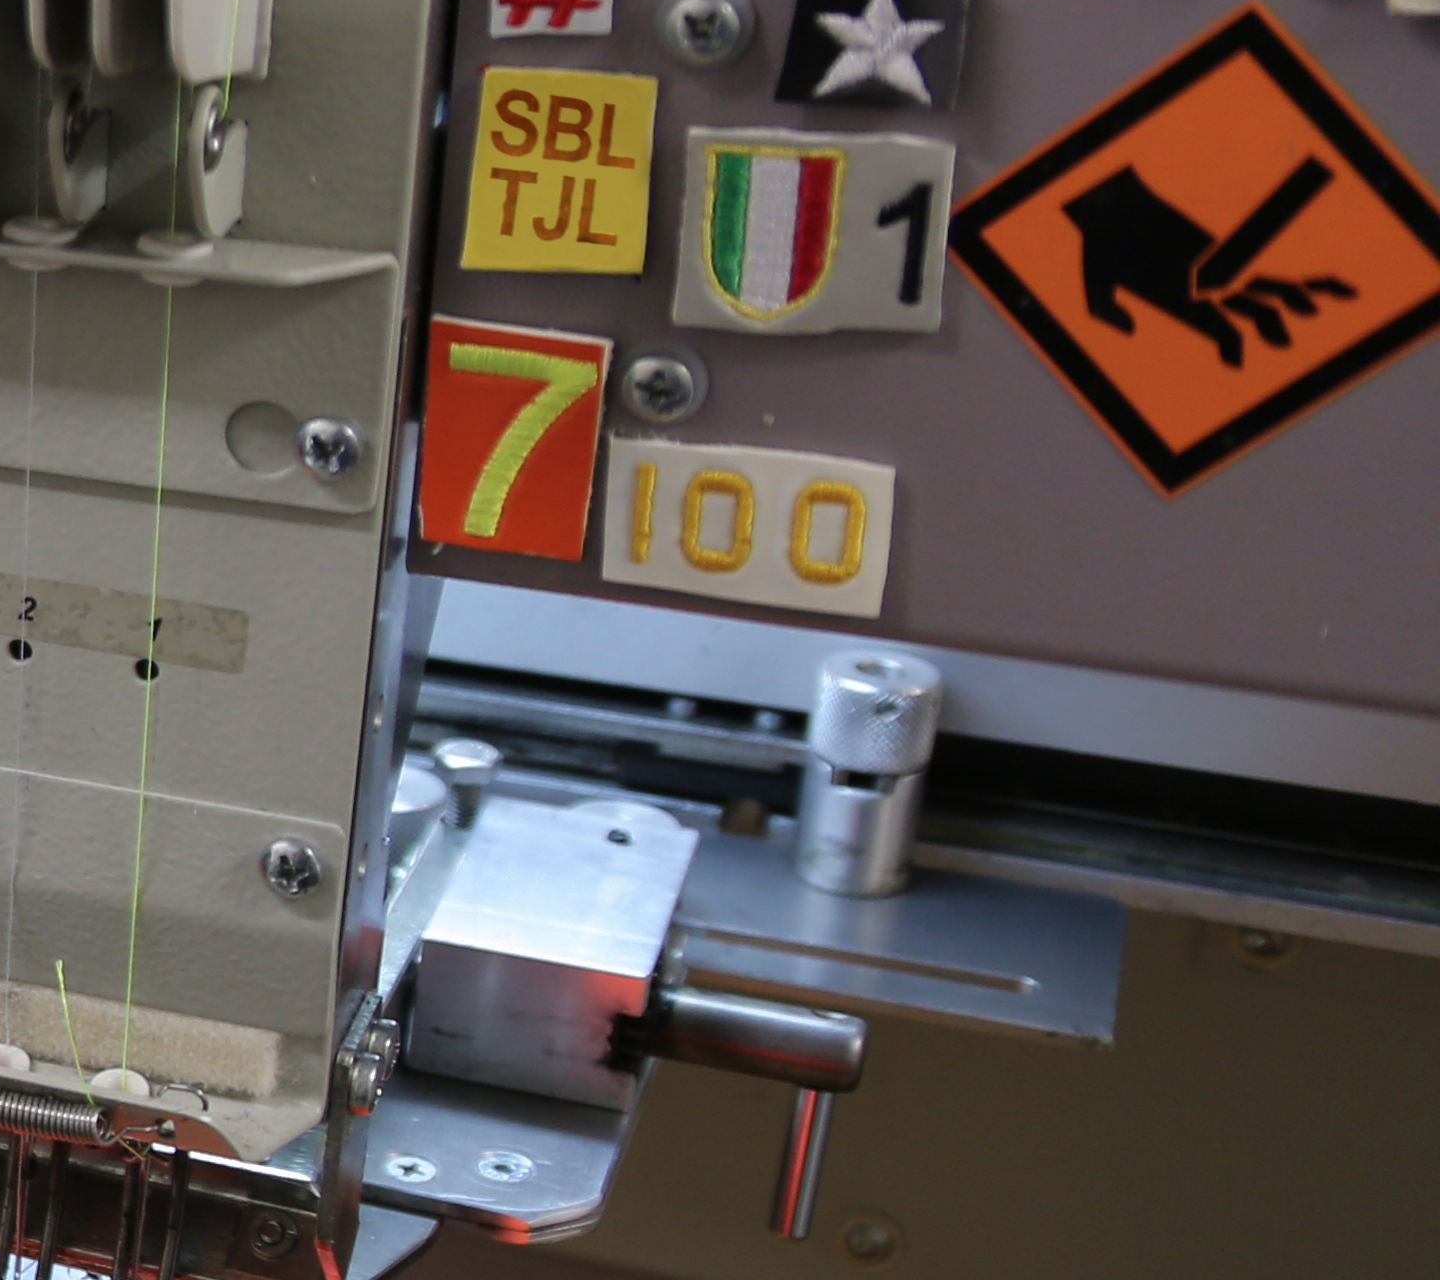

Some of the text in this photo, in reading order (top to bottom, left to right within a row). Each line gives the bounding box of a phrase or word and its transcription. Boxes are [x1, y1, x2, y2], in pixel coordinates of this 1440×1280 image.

[489, 88, 637, 170] SBL
[489, 167, 620, 246] TJL
[877, 181, 934, 306] 1
[449, 341, 598, 539] 7
[630, 463, 867, 586] 100
[18, 596, 37, 620] 2
